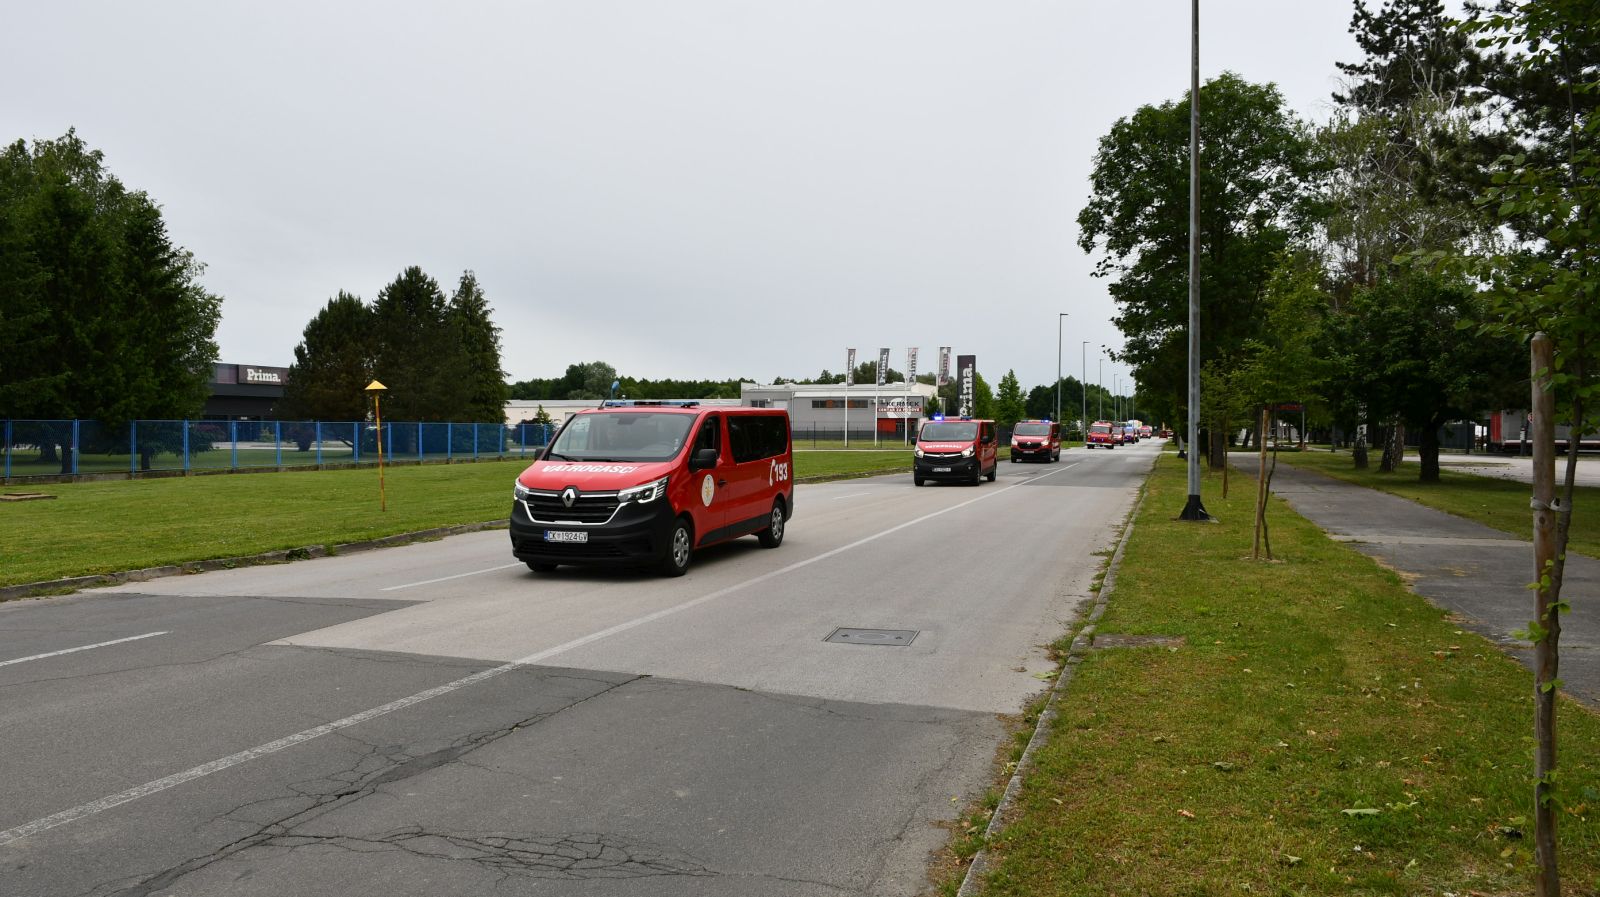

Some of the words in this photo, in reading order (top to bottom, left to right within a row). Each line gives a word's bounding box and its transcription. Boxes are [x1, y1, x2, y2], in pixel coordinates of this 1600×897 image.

[247, 368, 281, 382] Prima.
[542, 464, 638, 474] VATROGASCI
[775, 463, 788, 481] 193
